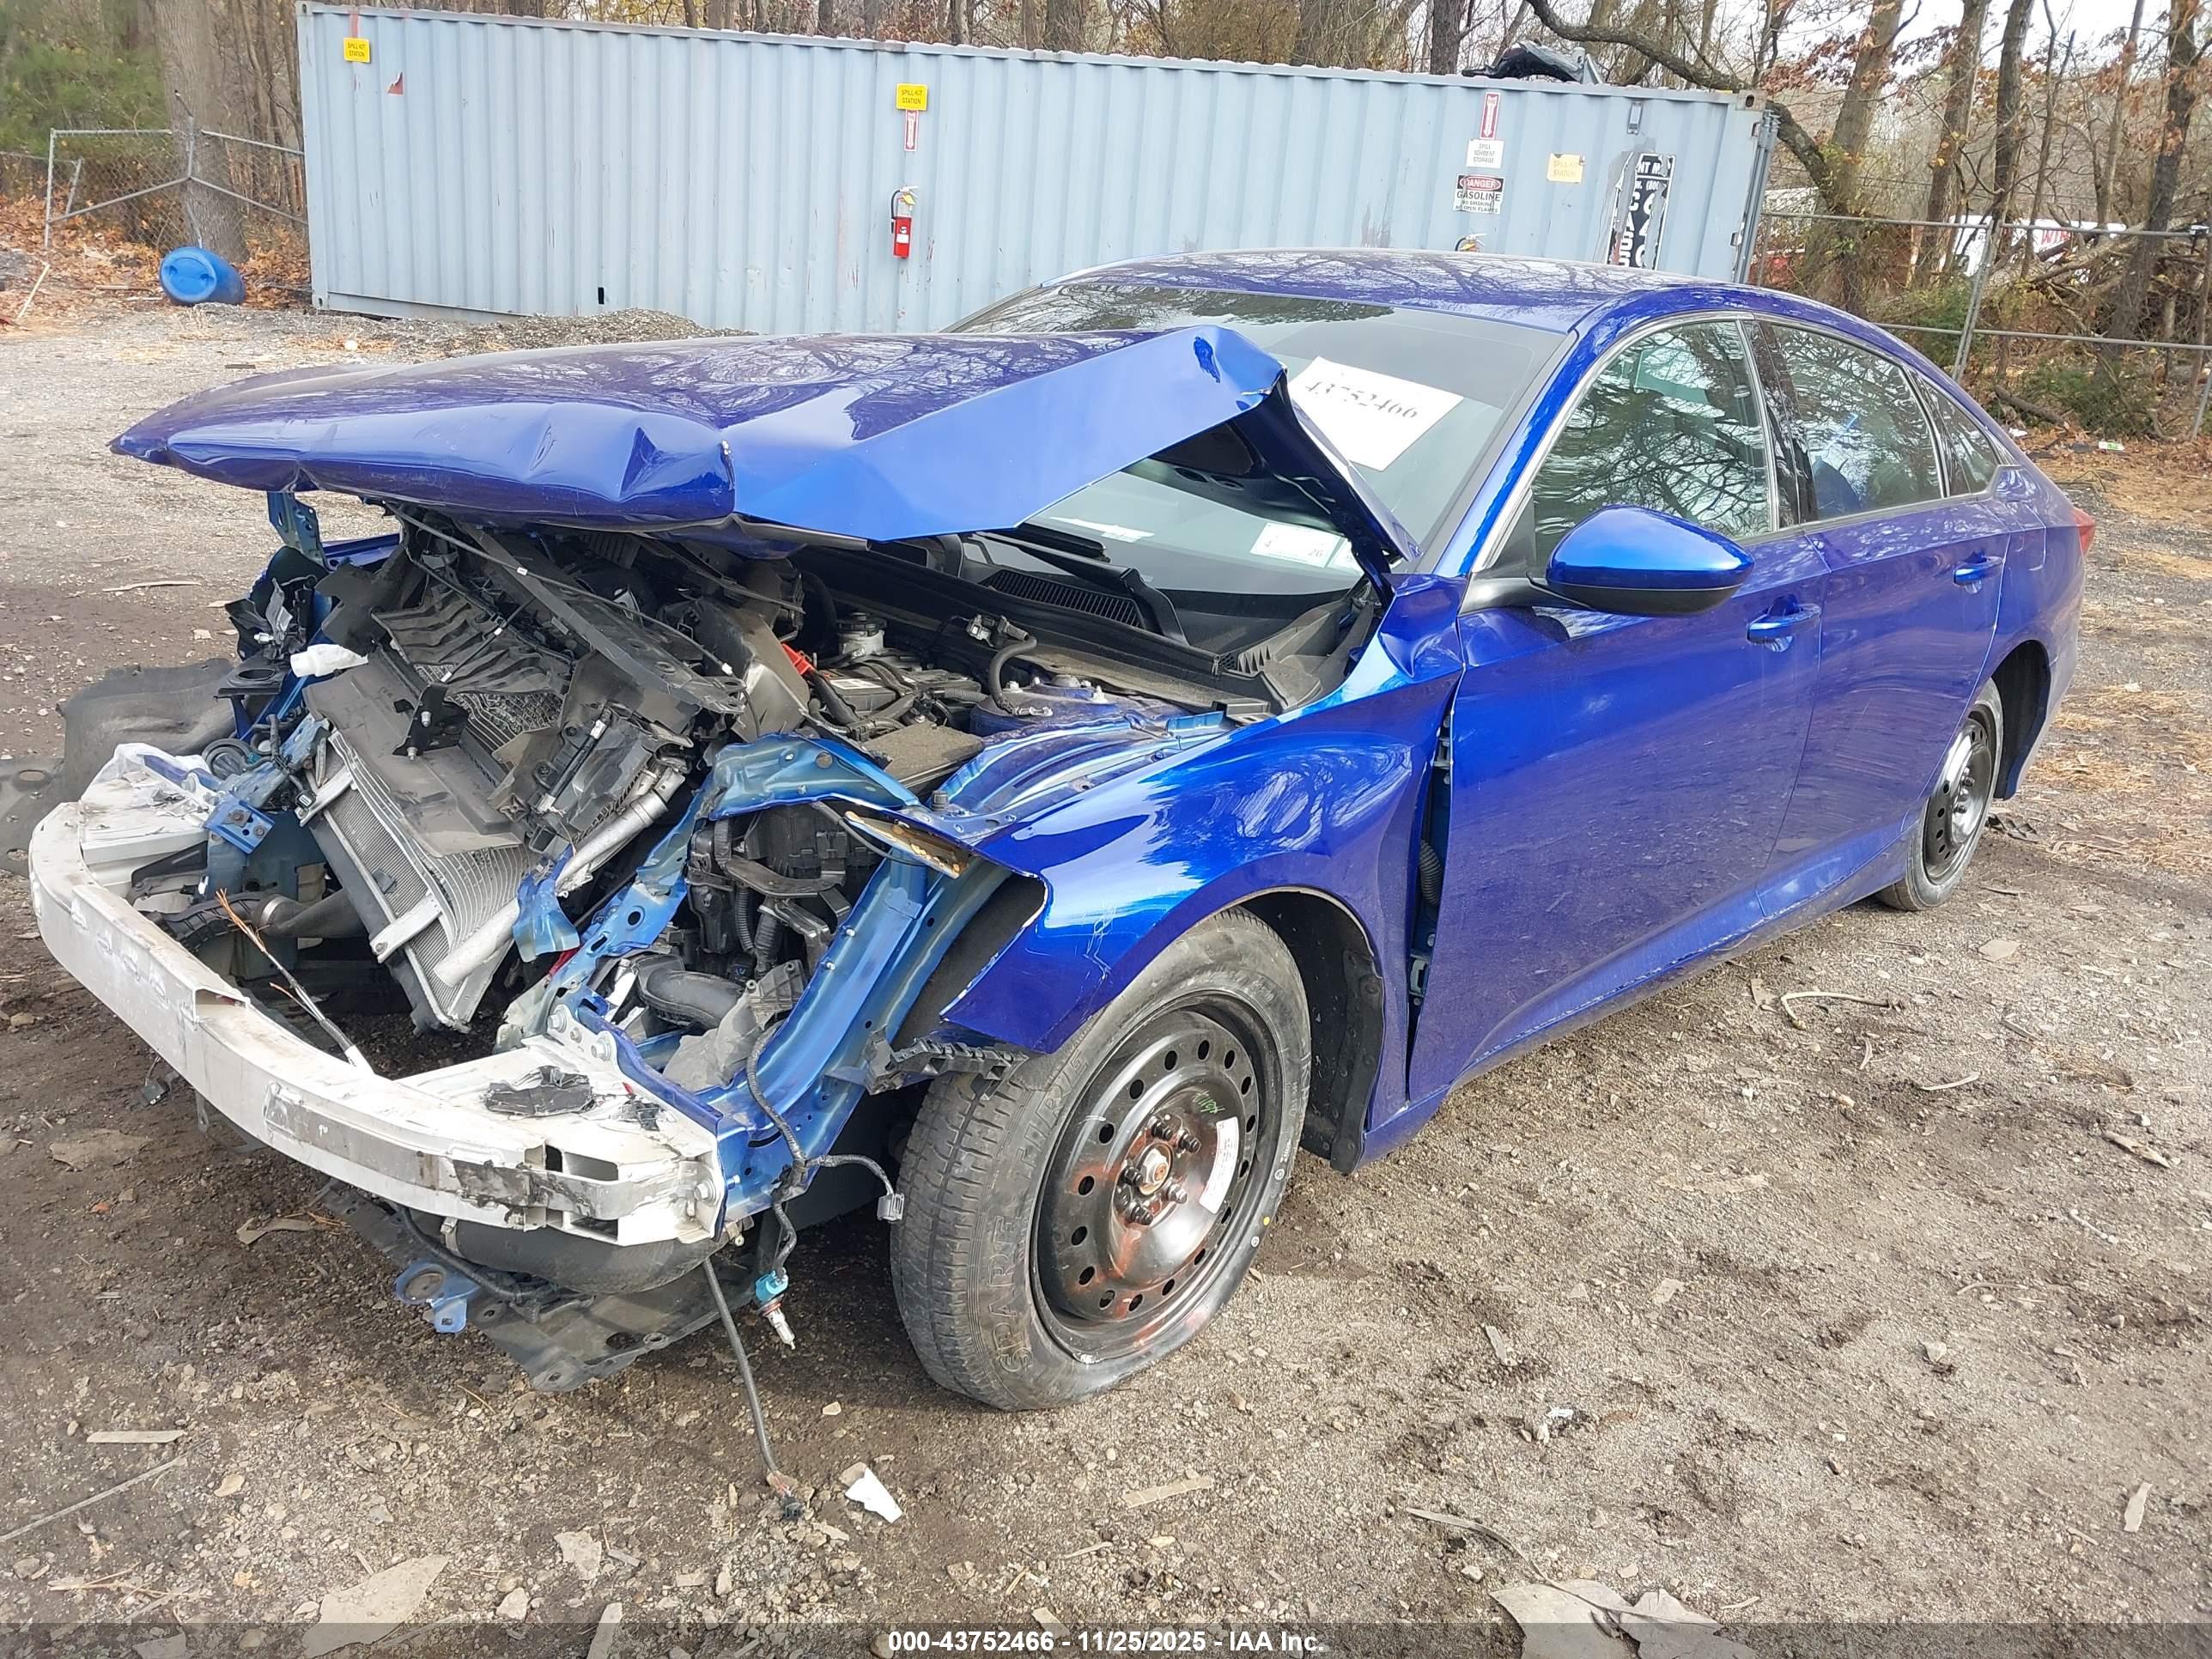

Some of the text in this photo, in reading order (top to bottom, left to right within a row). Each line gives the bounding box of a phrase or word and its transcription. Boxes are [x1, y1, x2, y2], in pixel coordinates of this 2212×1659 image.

[1463, 178, 1497, 188] DANGER
[1456, 191, 1502, 202] GASOLINE
[988, 1215, 1034, 1373] SPARE
